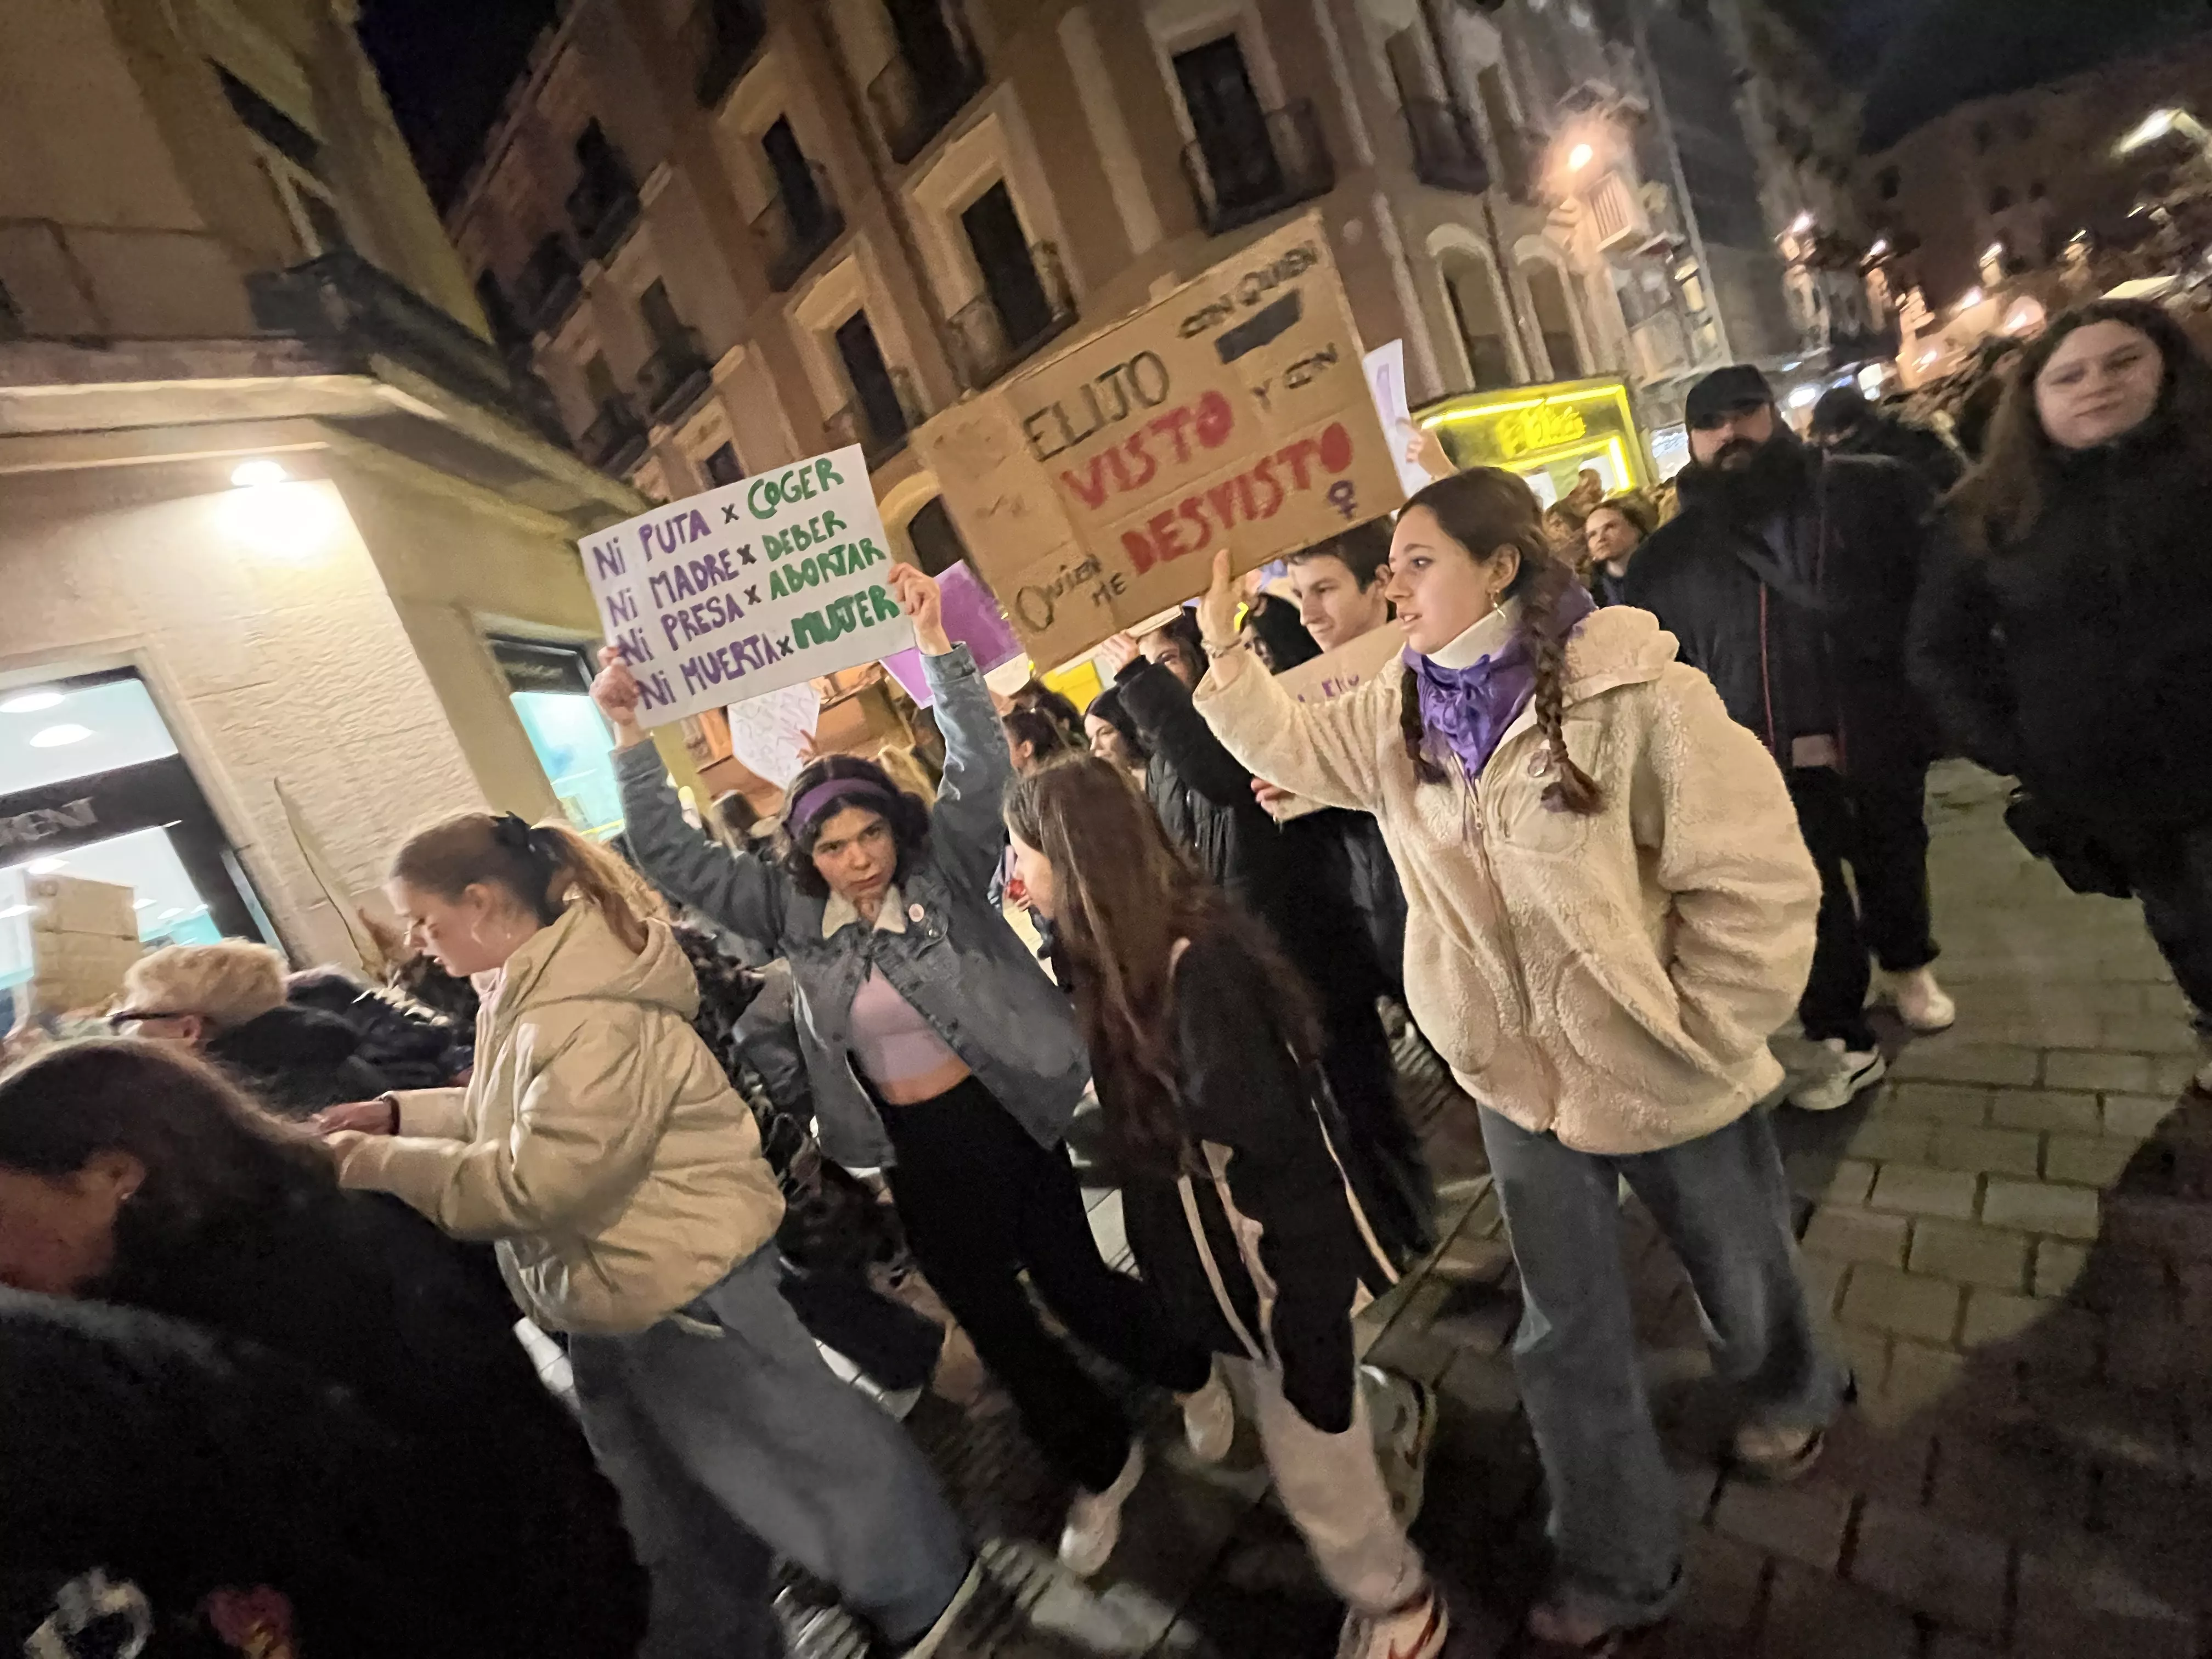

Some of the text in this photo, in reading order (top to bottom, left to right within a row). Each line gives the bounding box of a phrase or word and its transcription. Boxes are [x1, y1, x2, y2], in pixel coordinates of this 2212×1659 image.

[1022, 349, 1170, 462] ELIJO
[1059, 390, 1235, 511] VISTO
[1249, 376, 1273, 413] Y
[639, 509, 712, 562] PUTA
[747, 457, 844, 520] COGER
[1120, 421, 1353, 575] DESVISTO
[648, 548, 740, 610] MADRE
[761, 510, 847, 562] DEBER
[660, 593, 745, 651] PRESA
[769, 537, 887, 601] ABORTAR
[1092, 572, 1126, 607] ME
[679, 633, 782, 696] MUERTA
[790, 584, 900, 650] MUJER
